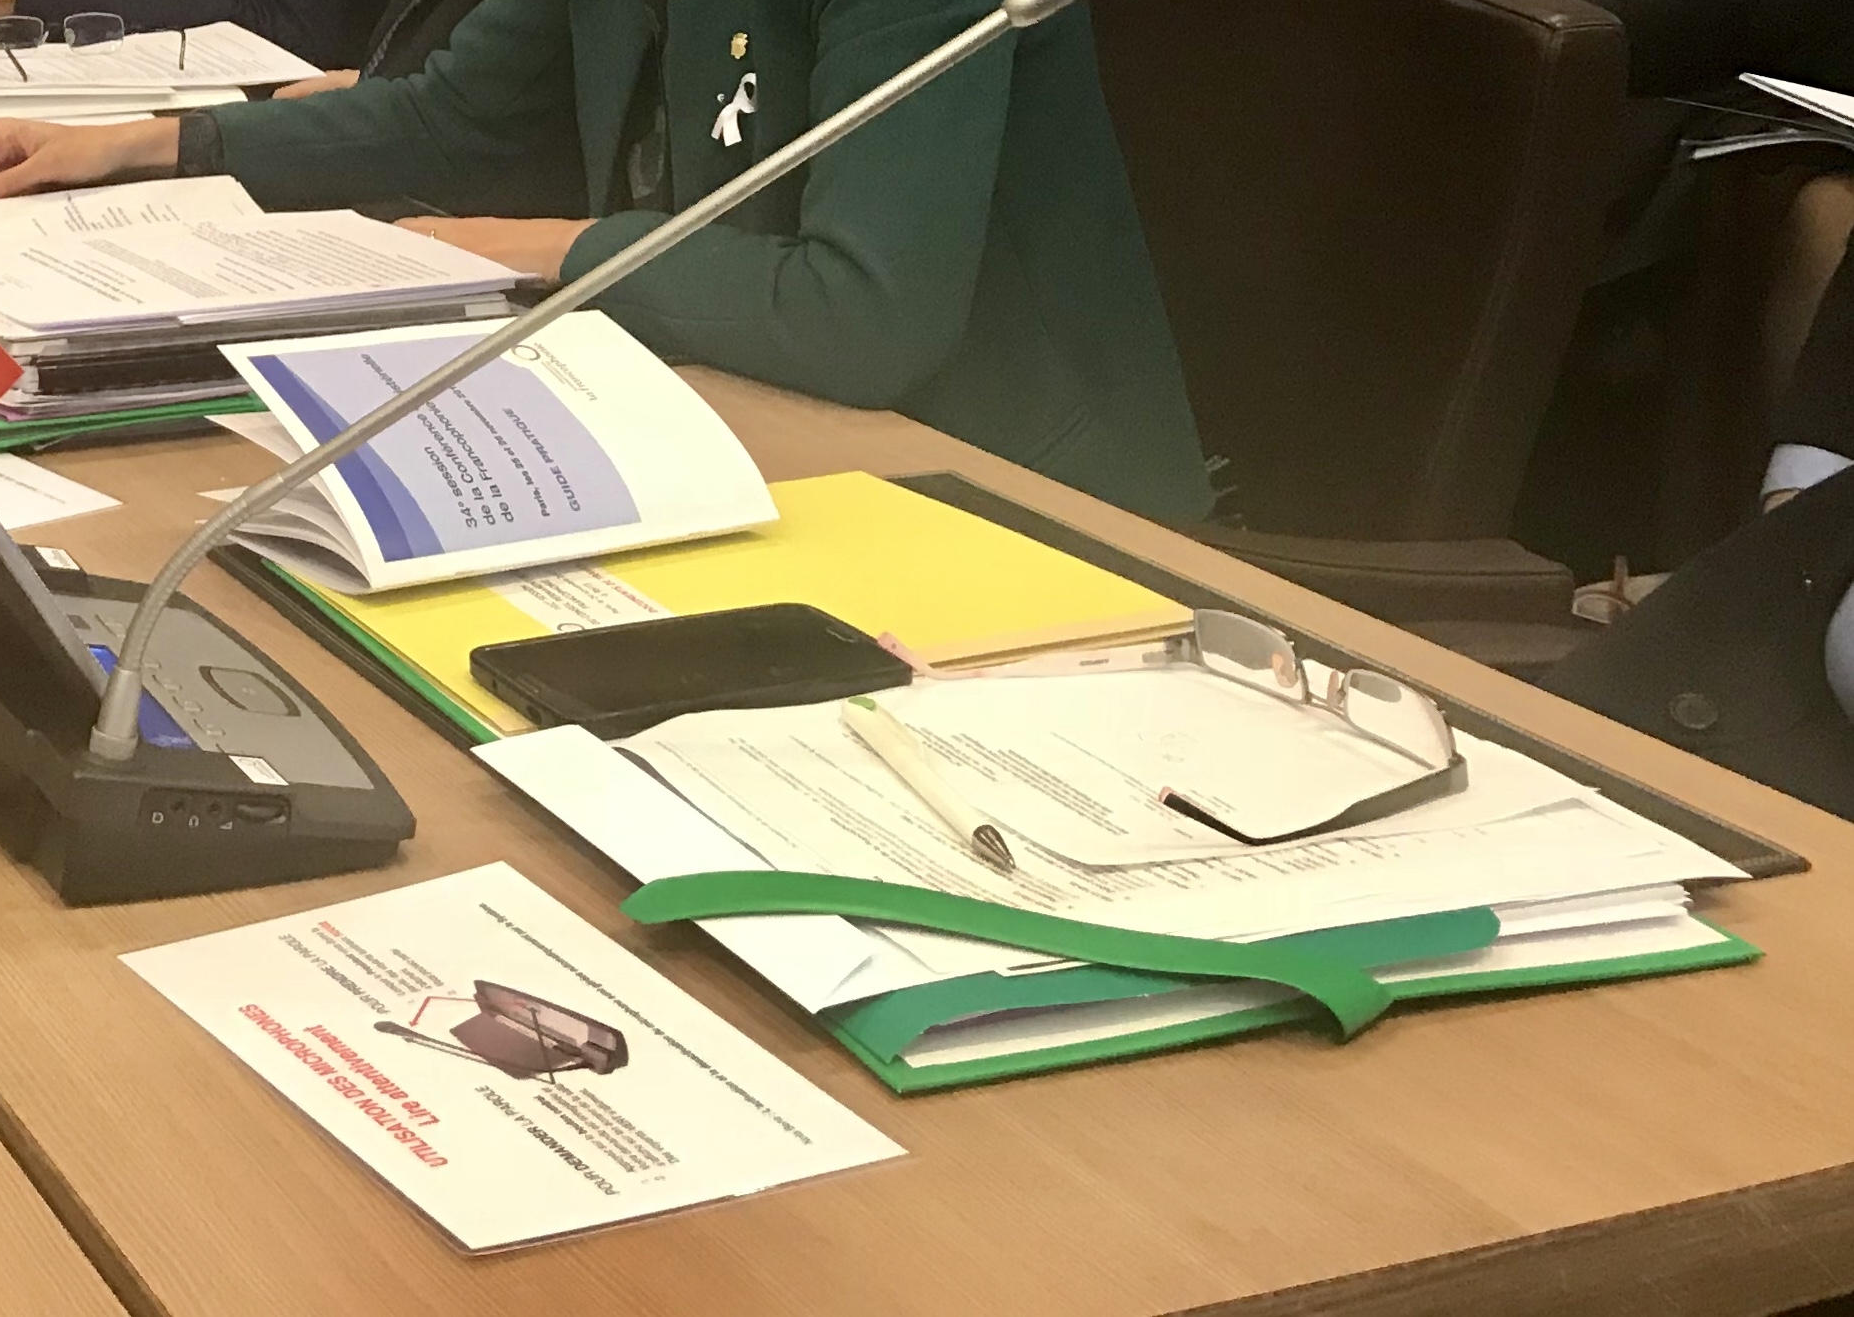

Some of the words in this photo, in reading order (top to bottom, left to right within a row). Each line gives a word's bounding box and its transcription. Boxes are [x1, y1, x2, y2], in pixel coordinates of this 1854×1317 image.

[463, 399, 498, 433] novembre
[424, 401, 492, 480] Francophonie
[502, 408, 553, 463] PRATIQUE
[503, 447, 515, 455] et
[422, 446, 463, 496] session
[471, 486, 484, 500] la
[489, 484, 502, 497] la
[533, 487, 551, 516] Paris,
[549, 465, 580, 511] GUIDE
[481, 504, 496, 525] de
[499, 502, 514, 522] de
[277, 933, 318, 958] PAROLE
[308, 956, 329, 967] LA
[319, 965, 366, 995] PRENDRE
[357, 994, 392, 1014] POUR
[235, 1003, 338, 1076] MICROPHONES
[300, 1024, 411, 1102] attentivement
[323, 1075, 367, 1099] DES
[472, 1084, 521, 1116] PAROLE
[393, 1099, 441, 1127] Lire
[510, 1114, 535, 1126] LA
[352, 1097, 450, 1167] UTILISATION
[524, 1125, 591, 1171] DEMANDER
[580, 1170, 621, 1195] POUR
